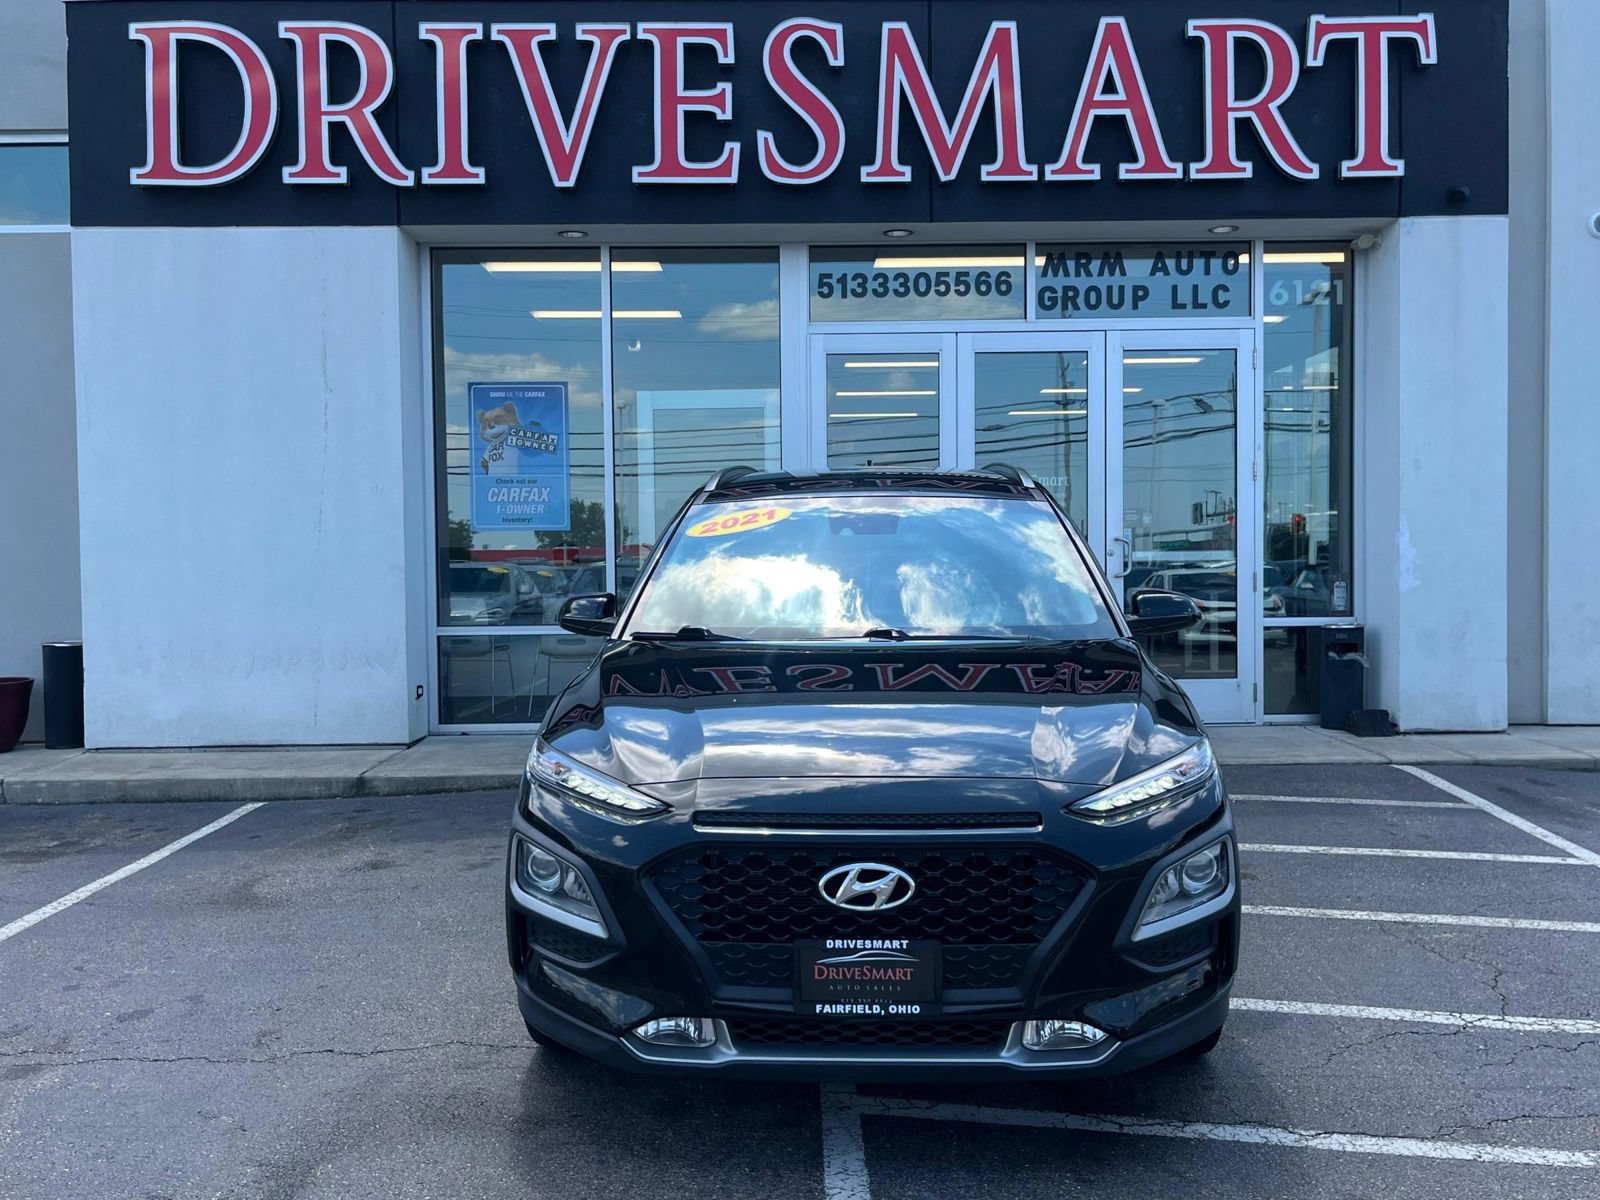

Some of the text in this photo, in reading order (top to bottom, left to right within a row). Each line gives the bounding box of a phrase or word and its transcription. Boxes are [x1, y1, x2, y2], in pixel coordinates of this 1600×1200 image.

[128, 12, 1438, 188] DRIVESMART
[1041, 250, 1240, 278] MRM AUTO
[817, 271, 1013, 299] 5133305566
[1037, 284, 1231, 311] GROUP LLC
[1268, 279, 1344, 306] 6121
[510, 427, 558, 444] CARFAX
[488, 487, 551, 502] CARFAX
[700, 509, 777, 535] 2021
[826, 940, 909, 949] DRIVESMART
[815, 1004, 921, 1016] FAIRFIELD, OHIO
